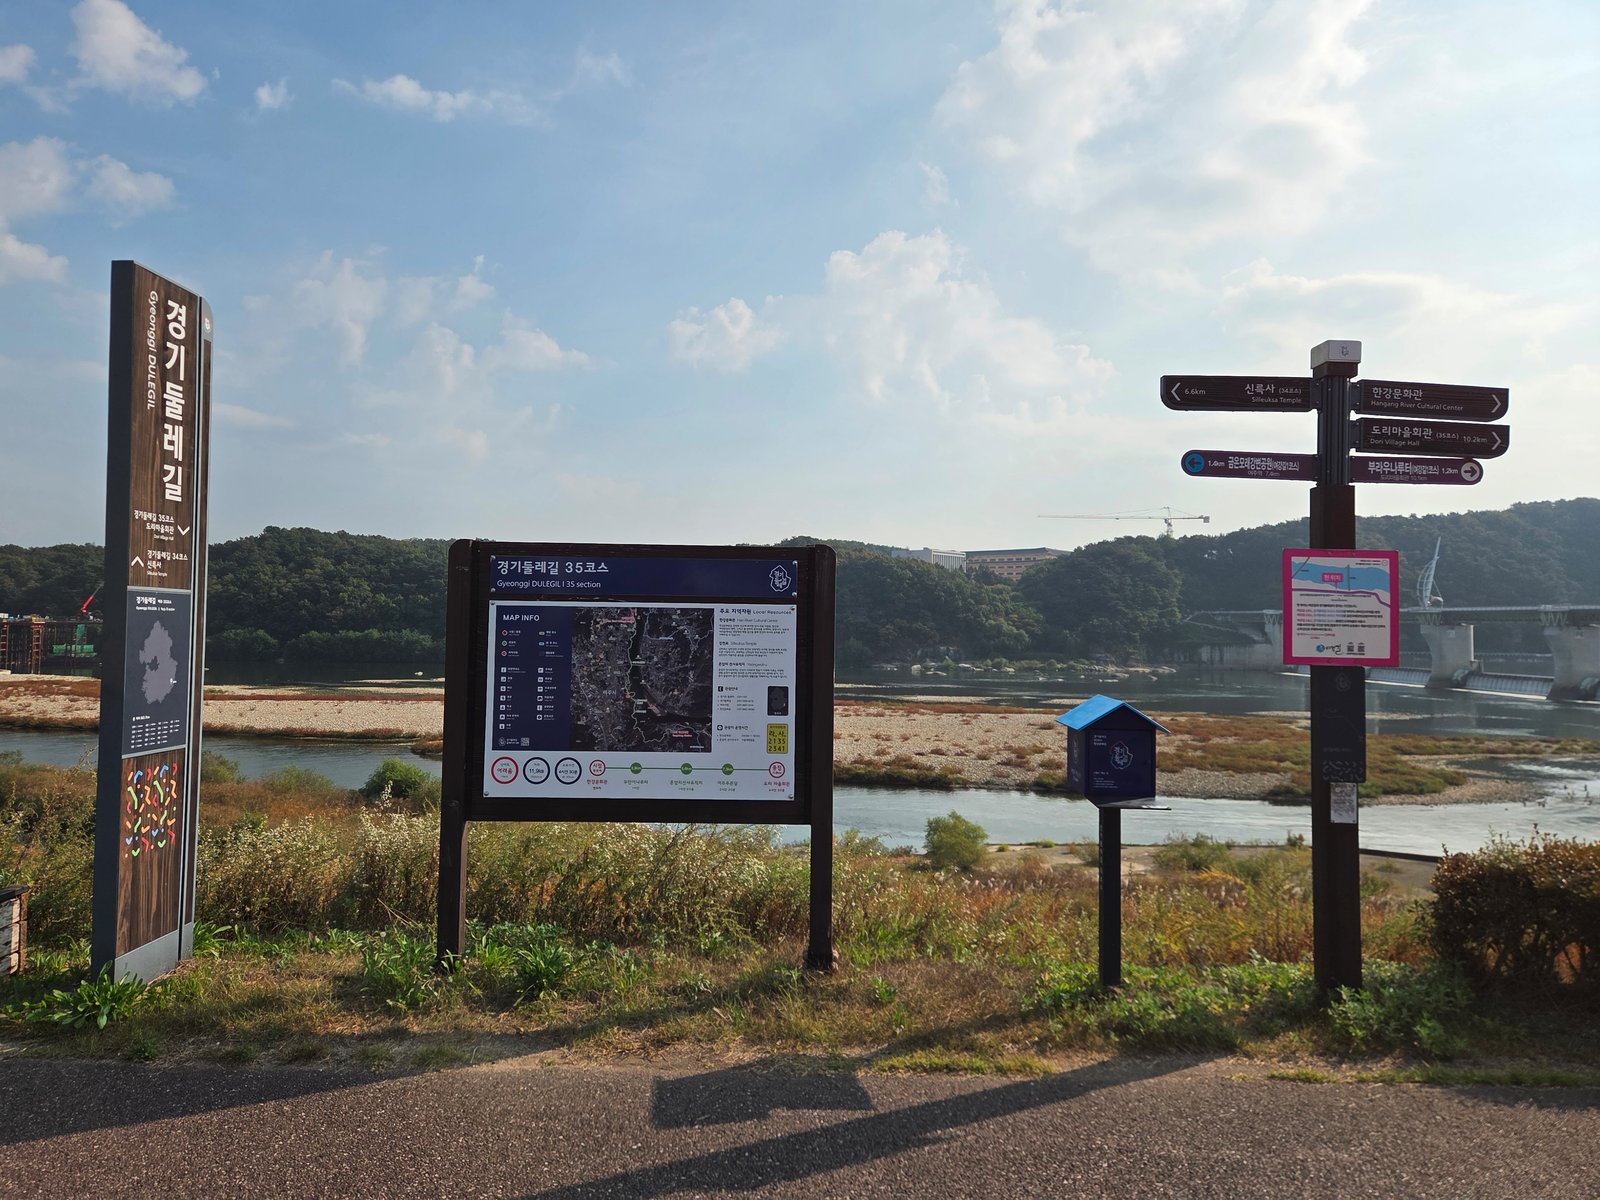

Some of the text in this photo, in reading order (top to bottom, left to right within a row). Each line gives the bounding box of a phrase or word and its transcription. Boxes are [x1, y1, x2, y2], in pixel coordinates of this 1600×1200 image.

[146, 290, 159, 411] Gyeonggi DULEGIL
[1245, 383, 1276, 395] 신륵사
[1371, 386, 1423, 401] 한강문화관
[162, 299, 187, 502] 경기둘레길
[1280, 396, 1302, 404] Temple
[1370, 400, 1399, 408] Hangang
[1417, 402, 1442, 410] Cultural
[1442, 403, 1464, 411] Center
[1370, 425, 1433, 439] 도리마을회관
[1436, 431, 1460, 439] (35코스)
[1384, 438, 1407, 447] Village
[1441, 467, 1459, 475] 1.2km
[133, 510, 175, 523] 경기둘레길 35코스
[146, 523, 175, 534] 도리마을회관
[147, 550, 188, 561] 경기둘레길 34코스
[497, 561, 609, 575] 경기둘레길 35코스
[497, 580, 531, 588] Gyeonggi
[532, 580, 561, 588] DULEGIL
[577, 580, 601, 588] section
